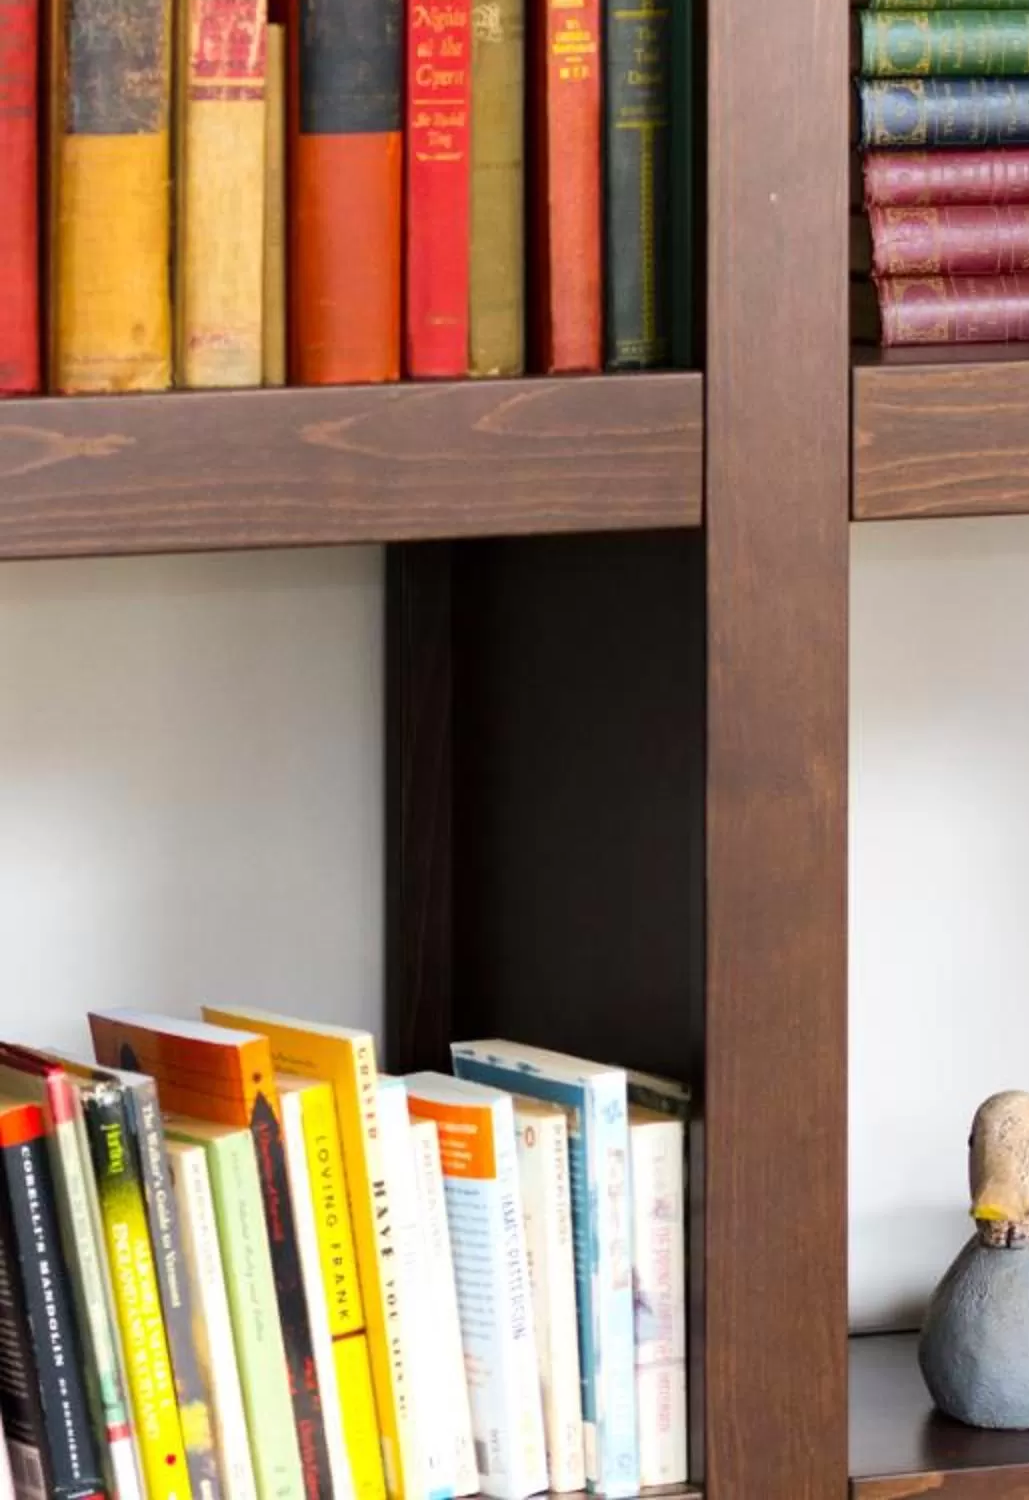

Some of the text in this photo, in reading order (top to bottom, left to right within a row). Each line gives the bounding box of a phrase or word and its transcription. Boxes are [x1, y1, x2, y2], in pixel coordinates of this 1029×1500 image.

[21, 1146, 64, 1367] CORELLI'S MANDOLIN
[156, 1190, 170, 1231] Guide
[315, 1135, 350, 1320] LOVING FRANK
[373, 1180, 394, 1257] HAVE
